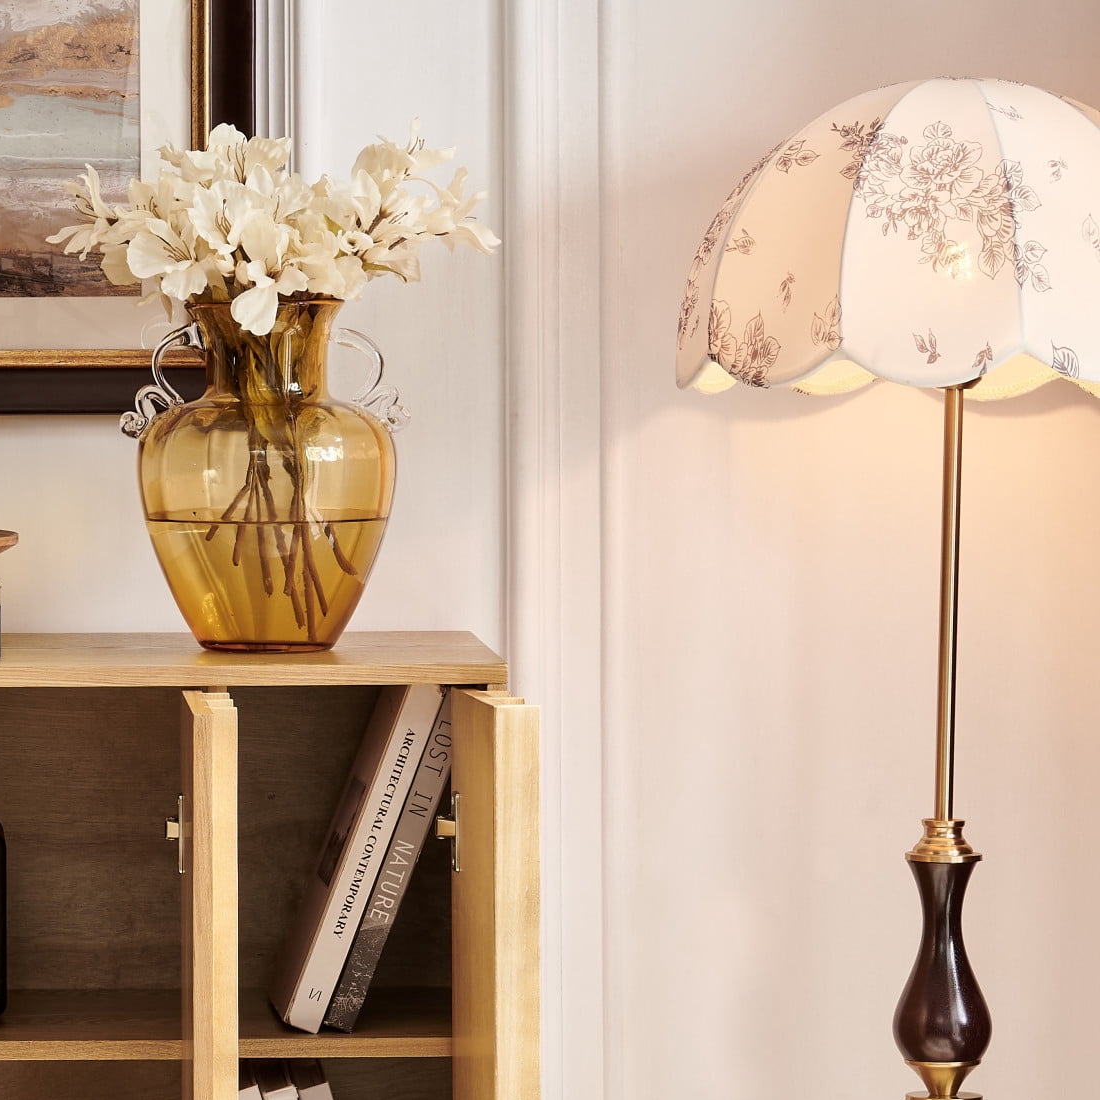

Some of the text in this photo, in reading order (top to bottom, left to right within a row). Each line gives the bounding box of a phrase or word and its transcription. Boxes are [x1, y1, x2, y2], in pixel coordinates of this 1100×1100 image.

[333, 728, 416, 939] ARCHITECTURAL CONTEMPORARY
[369, 720, 452, 923] LOST IN NATURE
